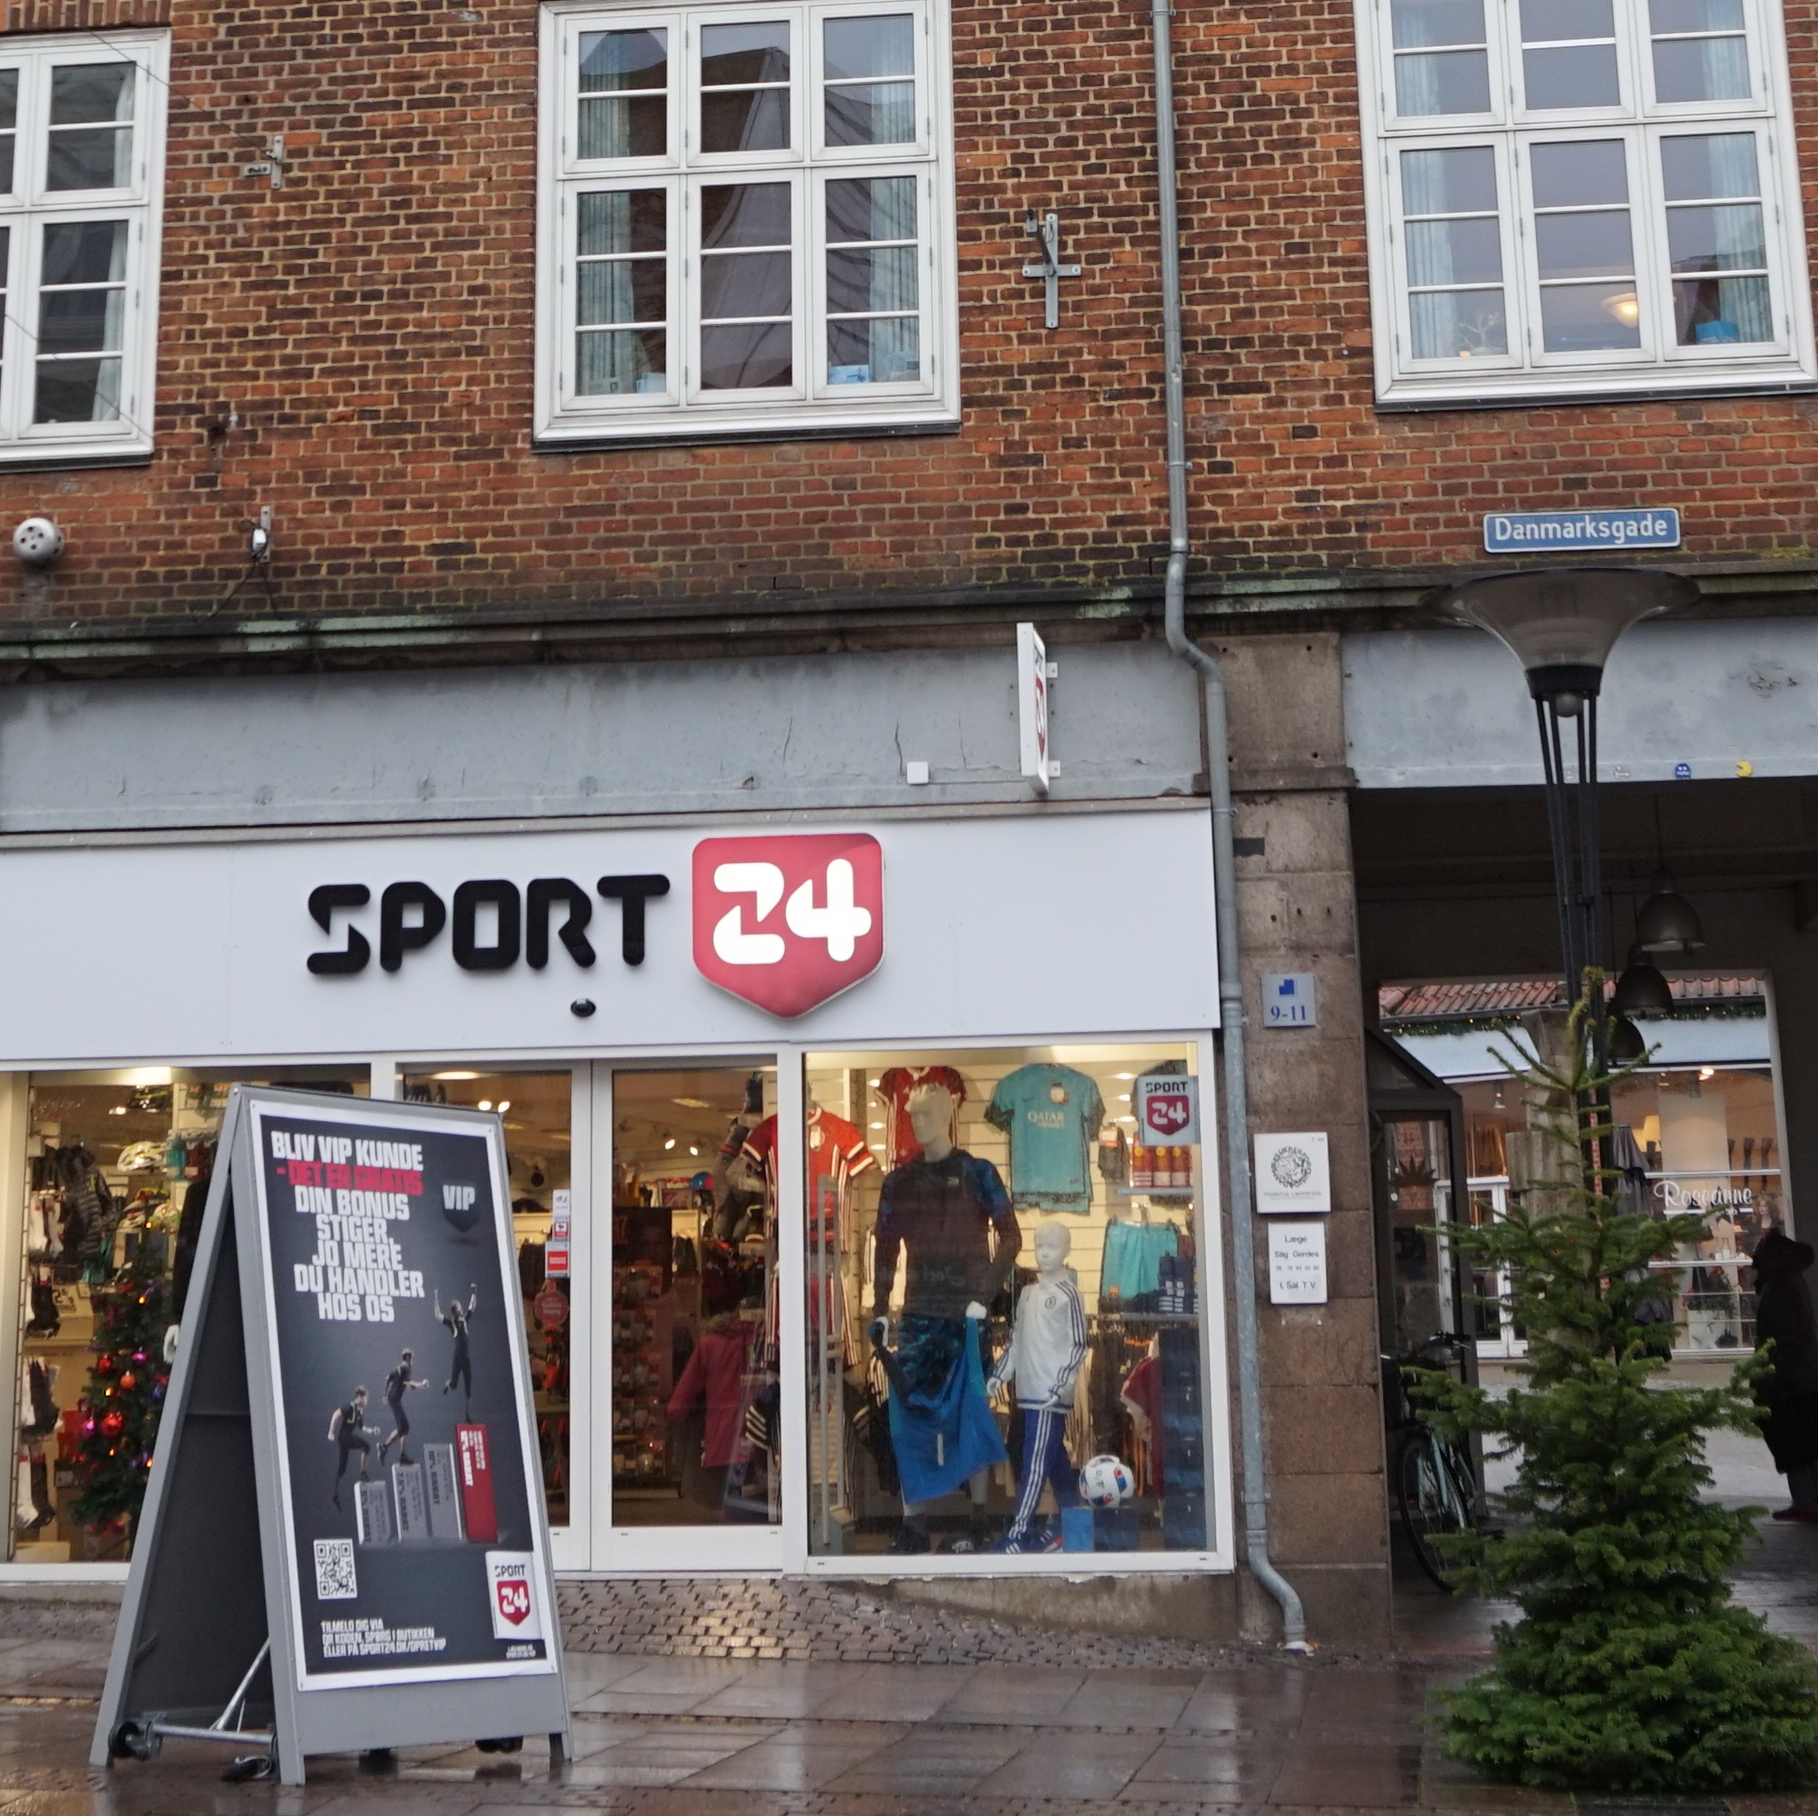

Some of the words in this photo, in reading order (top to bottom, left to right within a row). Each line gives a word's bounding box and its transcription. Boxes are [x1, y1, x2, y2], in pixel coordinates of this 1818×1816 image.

[1494, 512, 1669, 546] Danmarksgade
[306, 873, 671, 976] SPORT
[712, 857, 872, 966] 24
[1270, 1004, 1307, 1022] 9-11
[1145, 1079, 1189, 1095] SPORT
[1150, 1101, 1189, 1127] 24
[270, 1129, 315, 1162] BLIV
[317, 1134, 353, 1166] VIP
[354, 1138, 424, 1172] KUNDE
[287, 1159, 323, 1188] DET
[326, 1162, 351, 1191] ER
[353, 1165, 424, 1197] GRATIS
[294, 1183, 333, 1215] DIN
[335, 1187, 410, 1221] BONUS
[441, 1183, 476, 1212] VIP
[315, 1213, 395, 1248] STIGER,
[1283, 1234, 1309, 1245] Læge
[311, 1239, 340, 1267] JO
[342, 1241, 403, 1271] MERE
[293, 1262, 324, 1293] DU
[327, 1265, 426, 1298] HANDLER
[316, 1291, 363, 1322] HOS
[364, 1294, 396, 1324] OS
[494, 1564, 527, 1578] SPORT
[499, 1585, 529, 1615] 24
[369, 1617, 385, 1632] VIA
